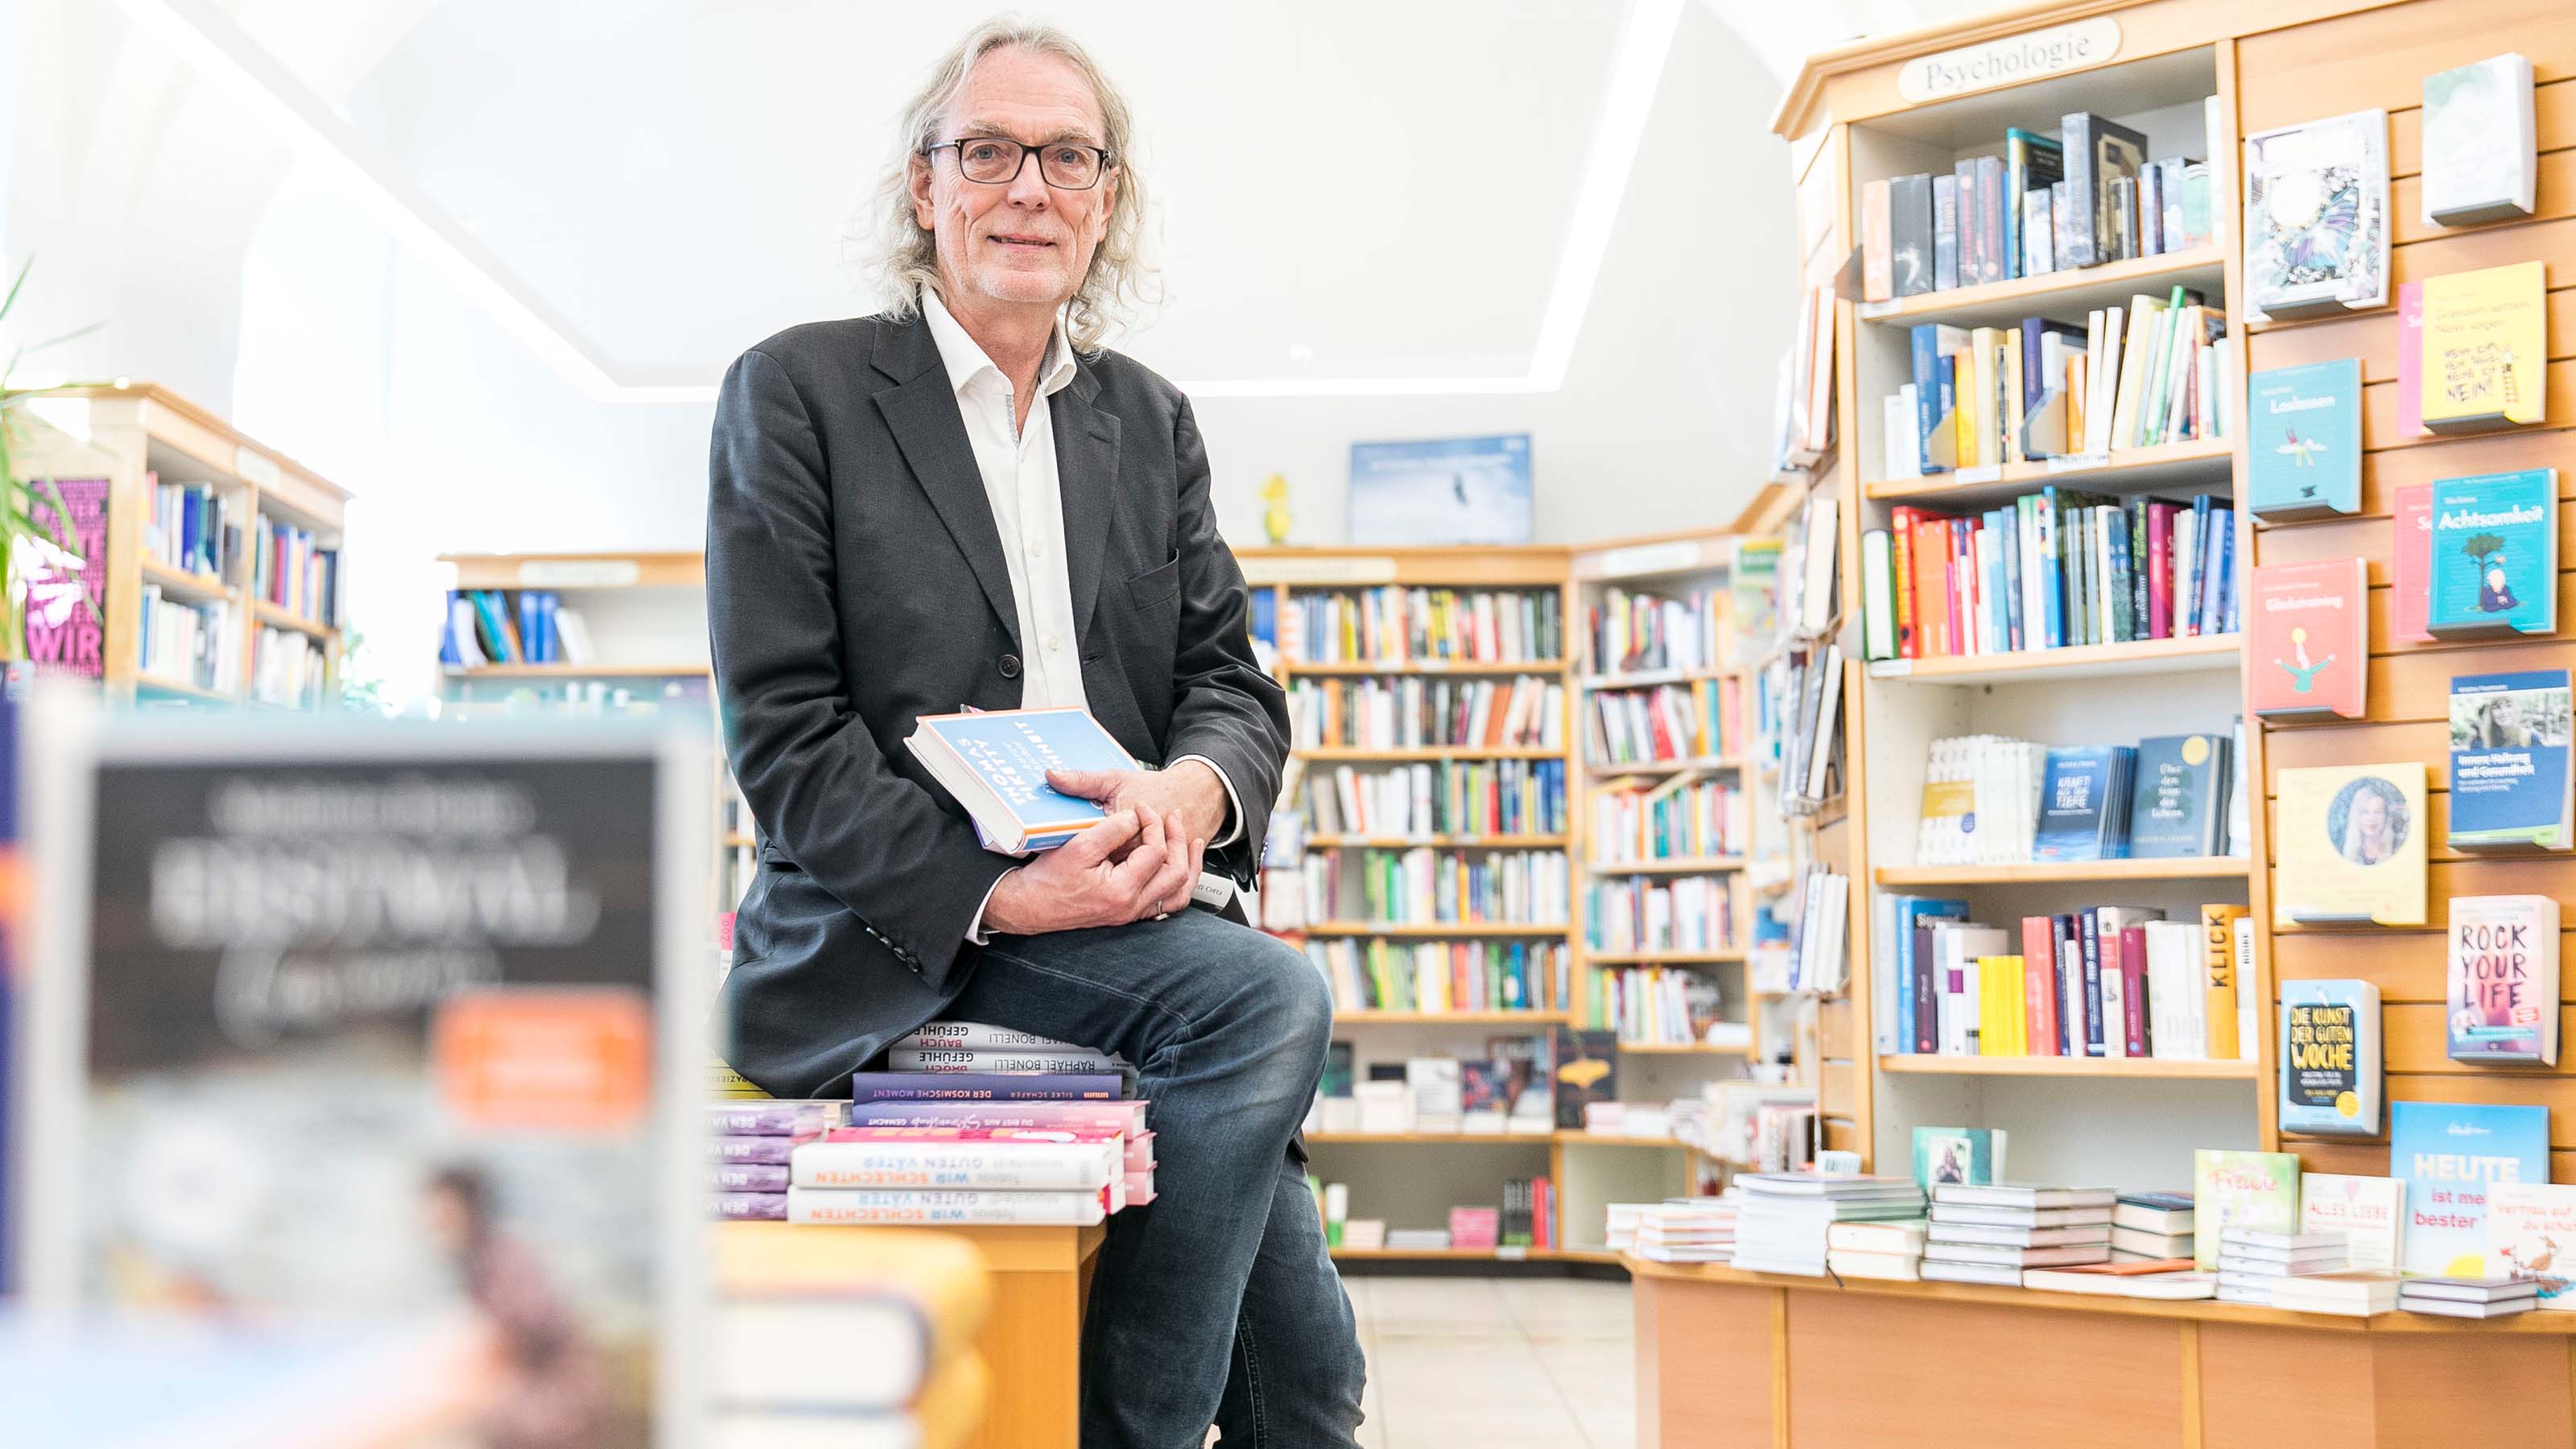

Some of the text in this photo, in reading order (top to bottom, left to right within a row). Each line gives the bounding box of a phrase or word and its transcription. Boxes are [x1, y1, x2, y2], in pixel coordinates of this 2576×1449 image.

[1926, 32, 2090, 90] Psychologie
[2438, 504, 2545, 530] Achtsamkeit
[27, 621, 102, 665] WIR
[957, 737, 1026, 805] THOMAS
[973, 739, 1040, 800] PIKETTY
[2458, 763, 2536, 778] und Gesundheit
[2057, 775, 2092, 788] KRAFT
[2462, 924, 2527, 951] ROCK
[2208, 913, 2227, 988] KLICK
[2462, 953, 2527, 980] YOUR
[2464, 982, 2522, 1008] LIFE
[2291, 1008, 2351, 1026] DIE KUNST
[989, 1034, 1036, 1044] BONELLI
[2291, 1026, 2353, 1044] DER GUTEN
[920, 1038, 963, 1047] BAUCH
[919, 1052, 973, 1064] GEFÜHLE
[2290, 1043, 2354, 1071] WOCHE
[994, 1059, 1096, 1071] RAPHAEL BONELLI
[873, 1089, 992, 1099] DER KOSMISCHE MOMENT
[1009, 1092, 1047, 1100] SCHÄFER
[729, 1116, 756, 1128] DEN
[868, 1117, 907, 1126] GEMACHT
[984, 1119, 1000, 1127] AUS
[1003, 1119, 1020, 1127] BIST
[1022, 1119, 1034, 1127] DU
[725, 1145, 750, 1157] DEN
[925, 1158, 983, 1169] GUTEN
[2413, 1153, 2520, 1183] HEUTE
[722, 1173, 748, 1185] DEN
[815, 1172, 969, 1184] WIR SCHLECHTEN
[921, 1192, 979, 1205] GUTEN
[2431, 1187, 2453, 1204] ist
[724, 1202, 749, 1214] DEN
[811, 1208, 965, 1220] WIR SCHLECHTEN
[2413, 1211, 2478, 1228] bester
